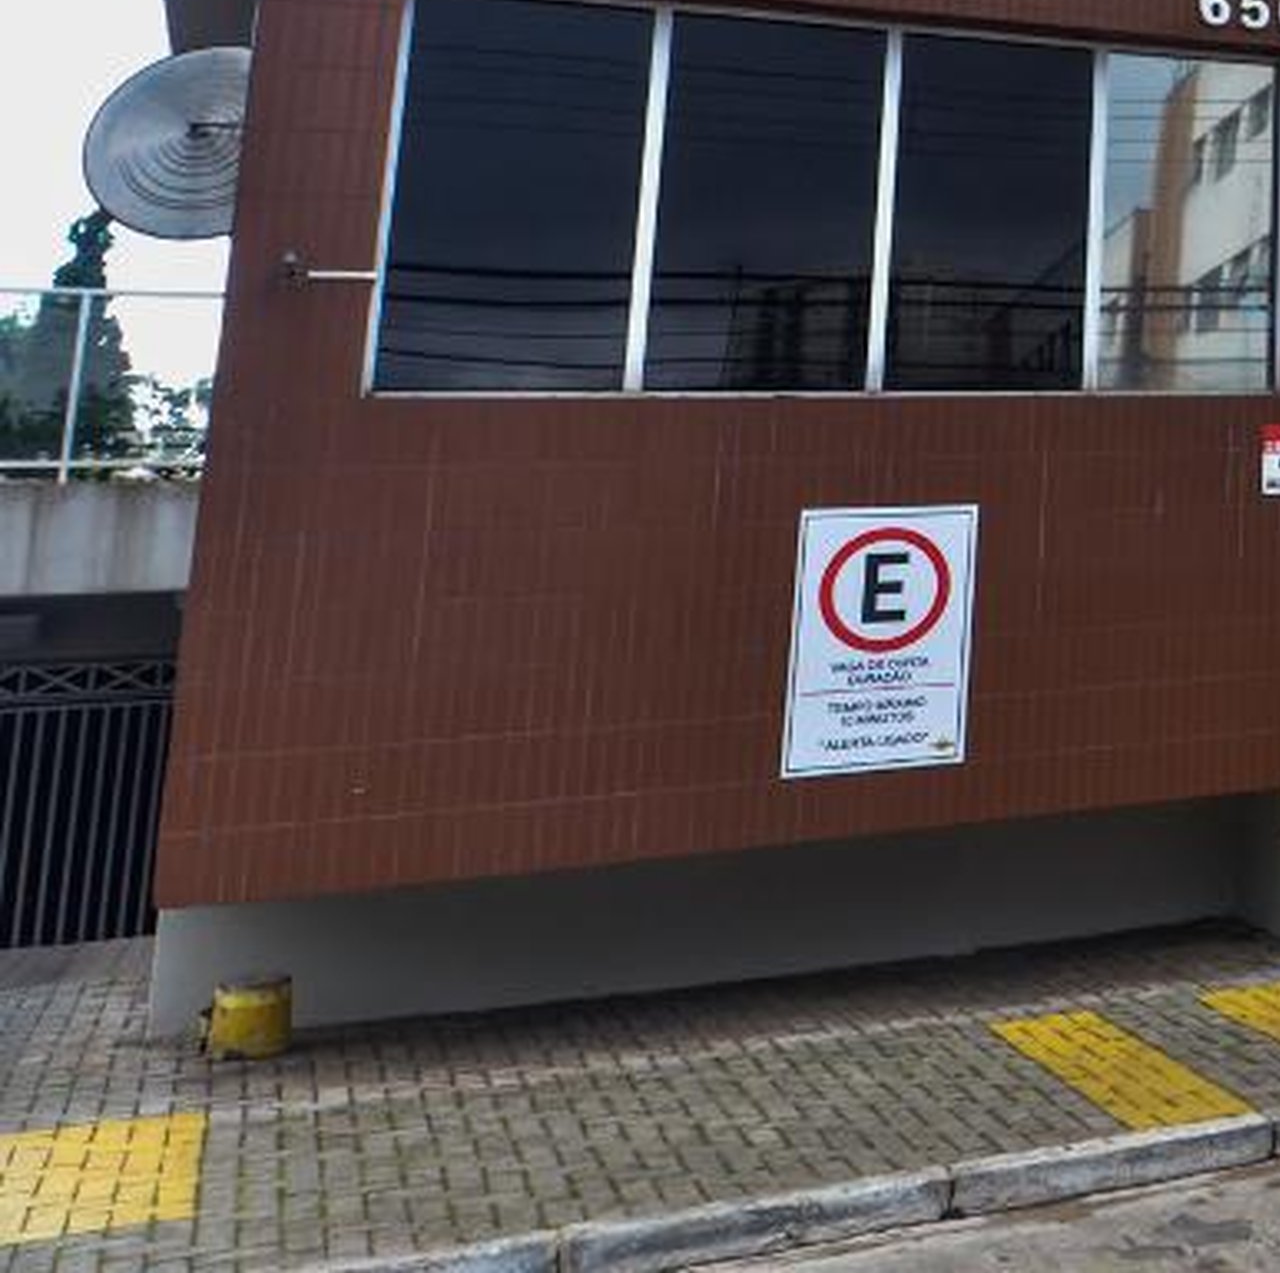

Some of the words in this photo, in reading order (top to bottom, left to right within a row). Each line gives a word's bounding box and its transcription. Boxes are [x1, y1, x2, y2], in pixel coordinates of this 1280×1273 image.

[861, 552, 910, 624] E
[867, 658, 885, 670] DE
[827, 699, 872, 713] TEMPO
